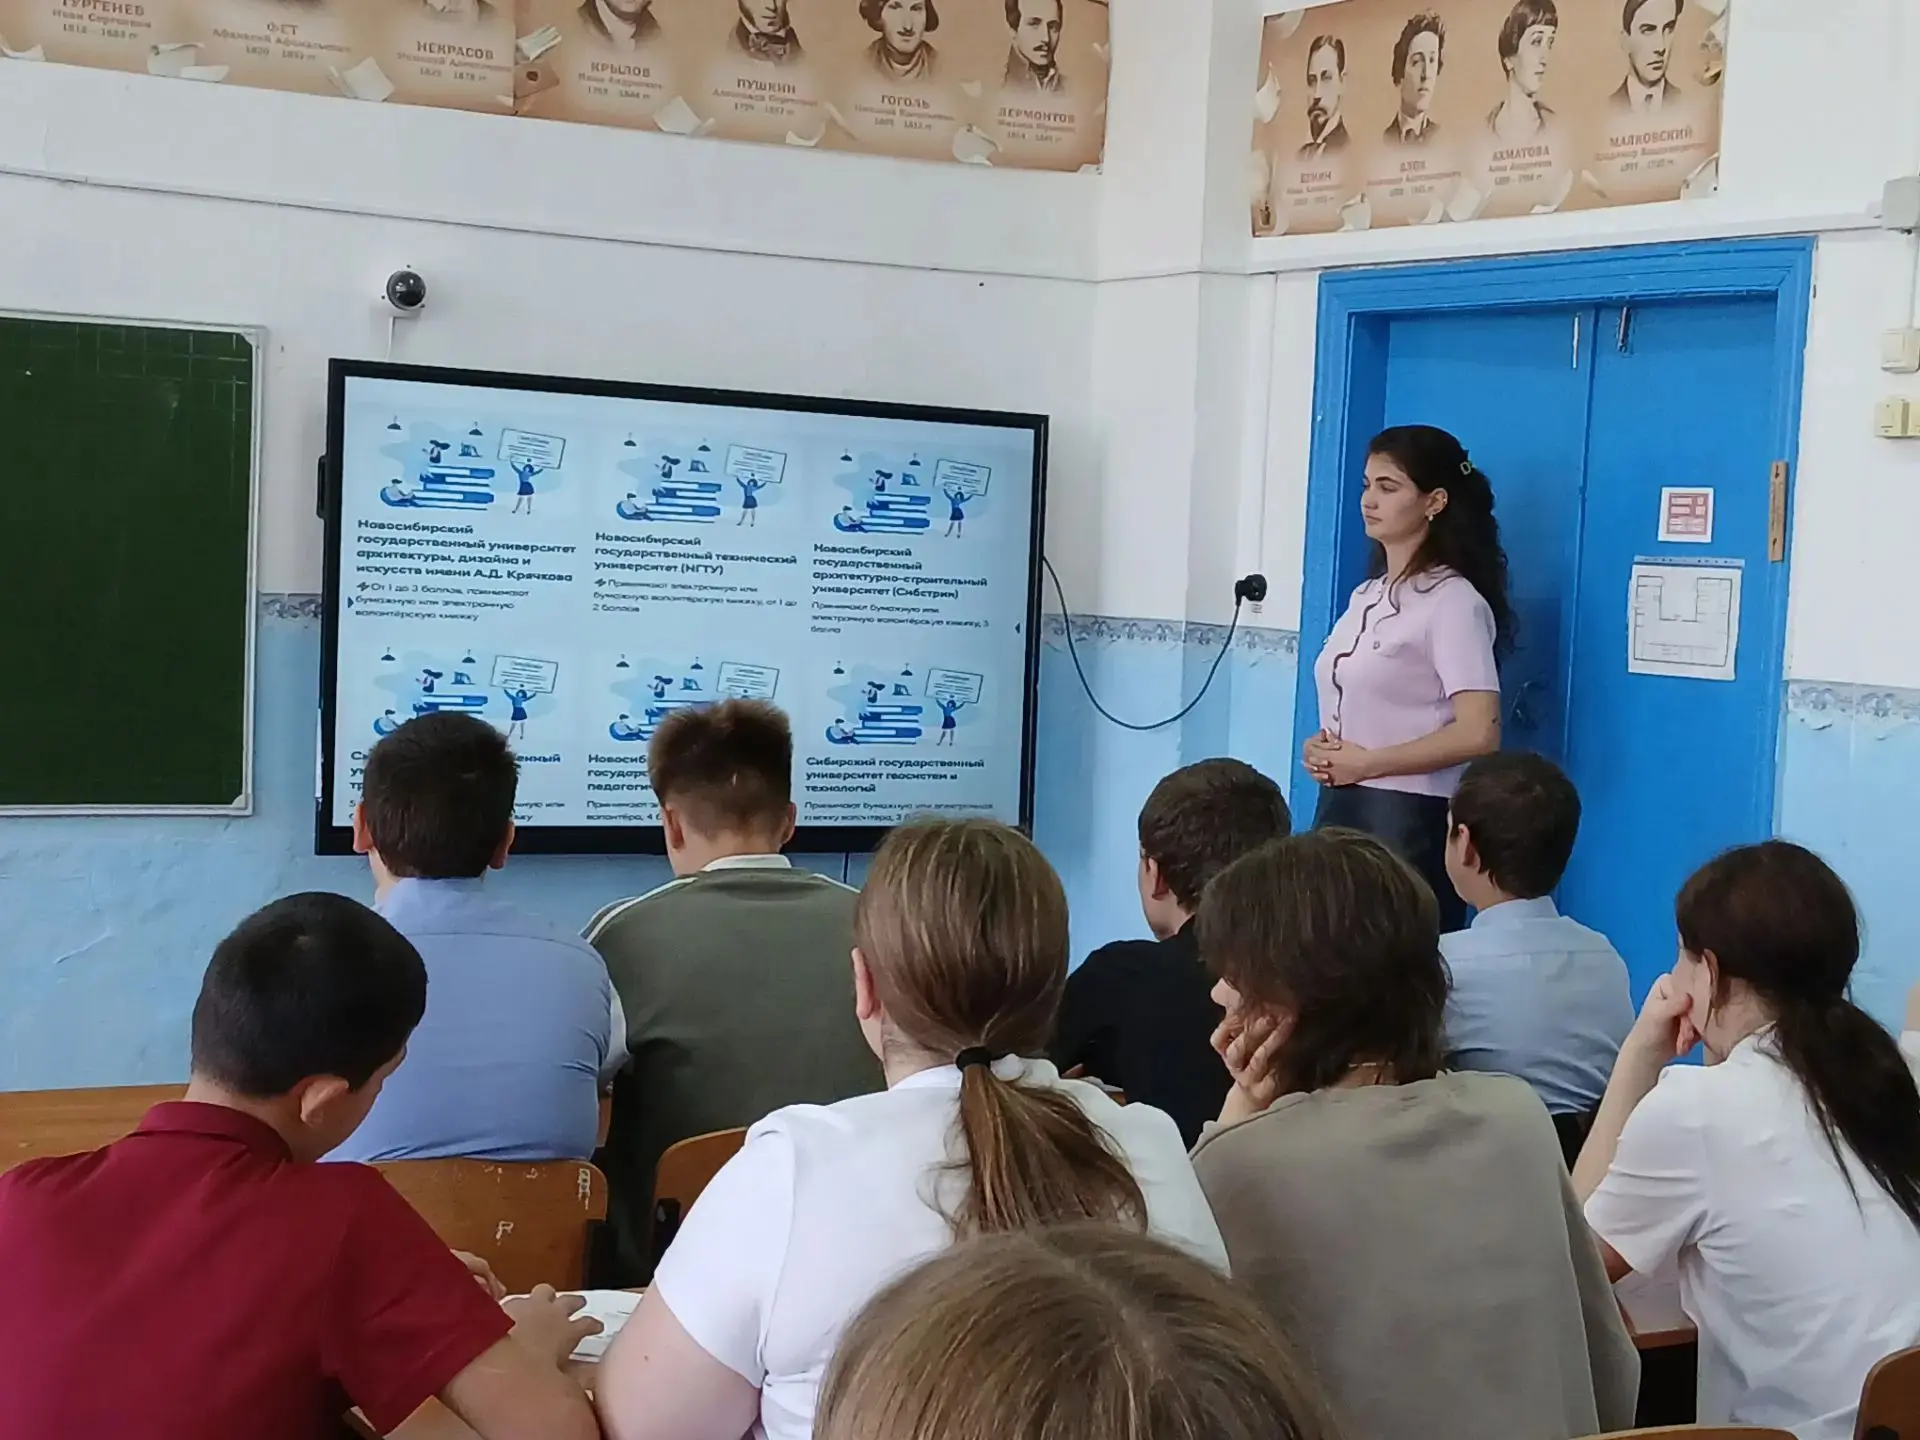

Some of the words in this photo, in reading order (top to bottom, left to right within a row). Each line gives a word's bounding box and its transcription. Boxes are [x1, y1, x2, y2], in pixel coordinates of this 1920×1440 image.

[416, 41, 494, 60] НЕКРАСОВ
[590, 61, 651, 78] КРЫЛОВ
[736, 78, 796, 94] ПУШКИН
[881, 94, 930, 110] ГОГОЛЬ
[998, 107, 1076, 124] ЛЕРМОНТОВ
[1609, 125, 1693, 148] МАЯКОВСКИЙ
[1492, 145, 1551, 161] АХМАТОВА
[358, 519, 474, 534] Новосибирский
[357, 535, 486, 549] государственный
[488, 542, 577, 554] университет
[595, 532, 702, 547] Новосибирский
[356, 549, 455, 563] архитектуры,
[458, 554, 520, 566] дизайна
[522, 558, 531, 566] и
[594, 547, 713, 560] государственный
[715, 553, 797, 565] технический
[813, 543, 913, 557] Новосибирский
[593, 561, 678, 573] университет
[681, 562, 724, 576] (НГТУ)
[813, 558, 923, 571] государственный
[356, 565, 422, 576] искусств
[425, 567, 471, 577] имени
[473, 568, 504, 579] А.Д.
[506, 569, 573, 582] Крячкова
[812, 571, 988, 587] архитектурно-строительный
[811, 585, 891, 596] университет
[892, 586, 959, 600] (Сибстрин)
[592, 603, 600, 612] 2
[588, 753, 649, 764] Новосиб
[806, 757, 877, 768] Сибирский
[879, 758, 985, 769] государственный
[805, 771, 885, 781] университет
[886, 772, 948, 781] геосистем
[587, 783, 654, 792] педагоги
[804, 783, 877, 793] технологий
